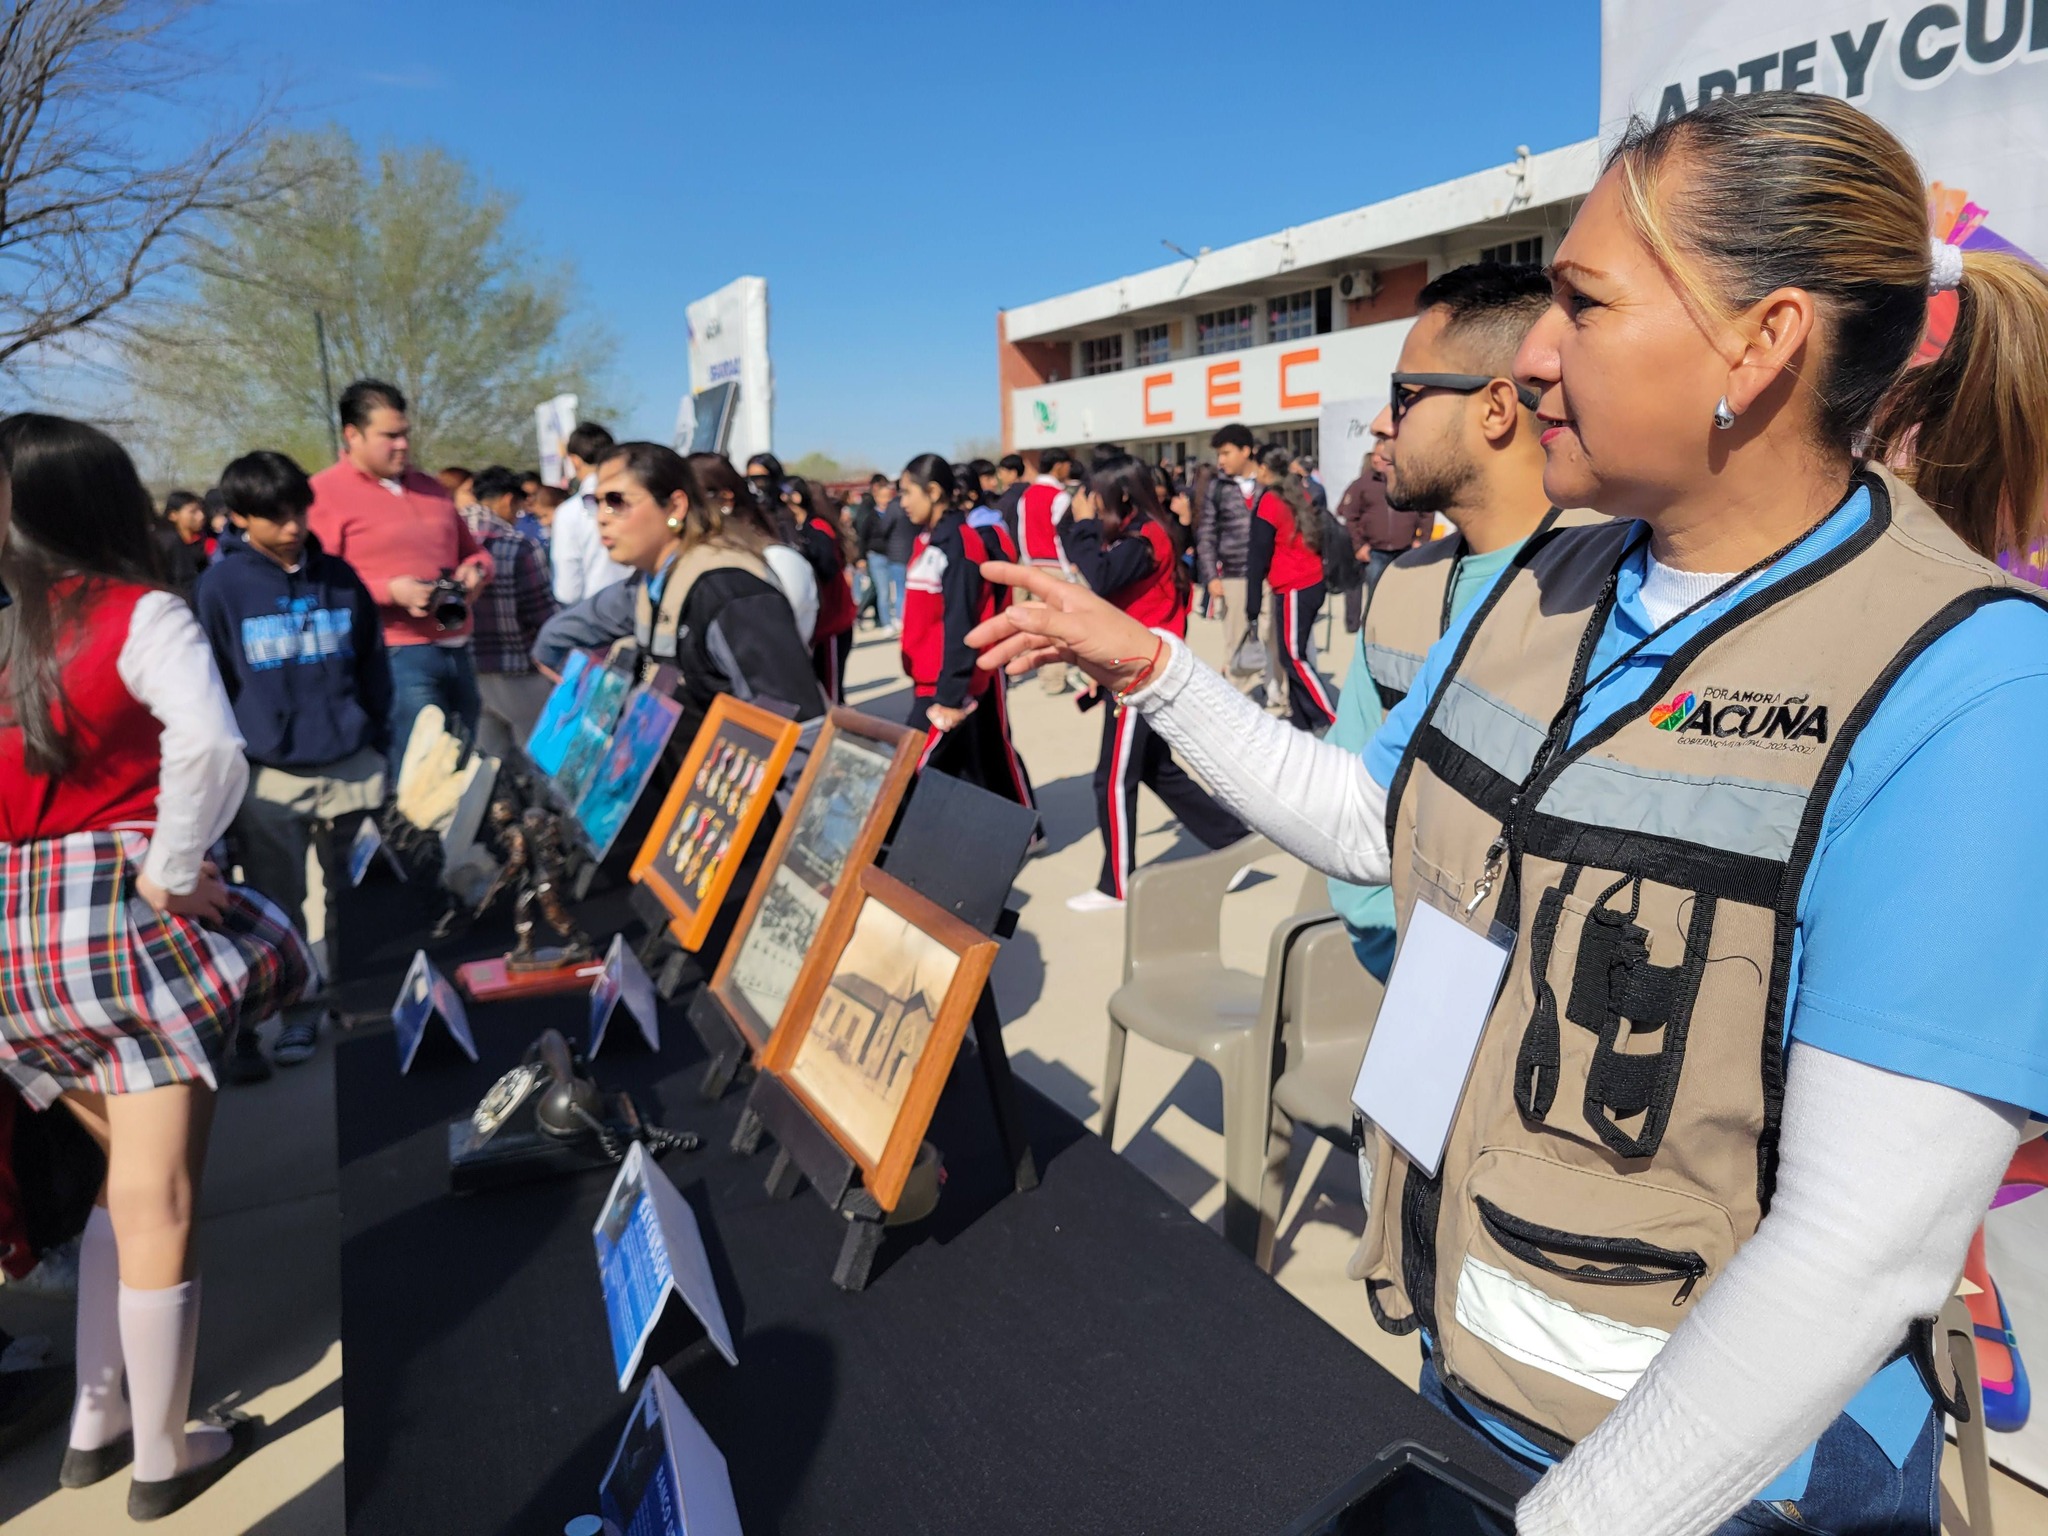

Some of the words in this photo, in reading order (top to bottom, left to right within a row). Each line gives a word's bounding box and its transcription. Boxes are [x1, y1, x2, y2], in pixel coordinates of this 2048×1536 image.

[1831, 18, 1888, 98] Y
[1900, 0, 2048, 79] CU
[1676, 693, 1828, 744] ACUÑA
[1703, 687, 1728, 699] POR
[1729, 690, 1774, 703] AMOR
